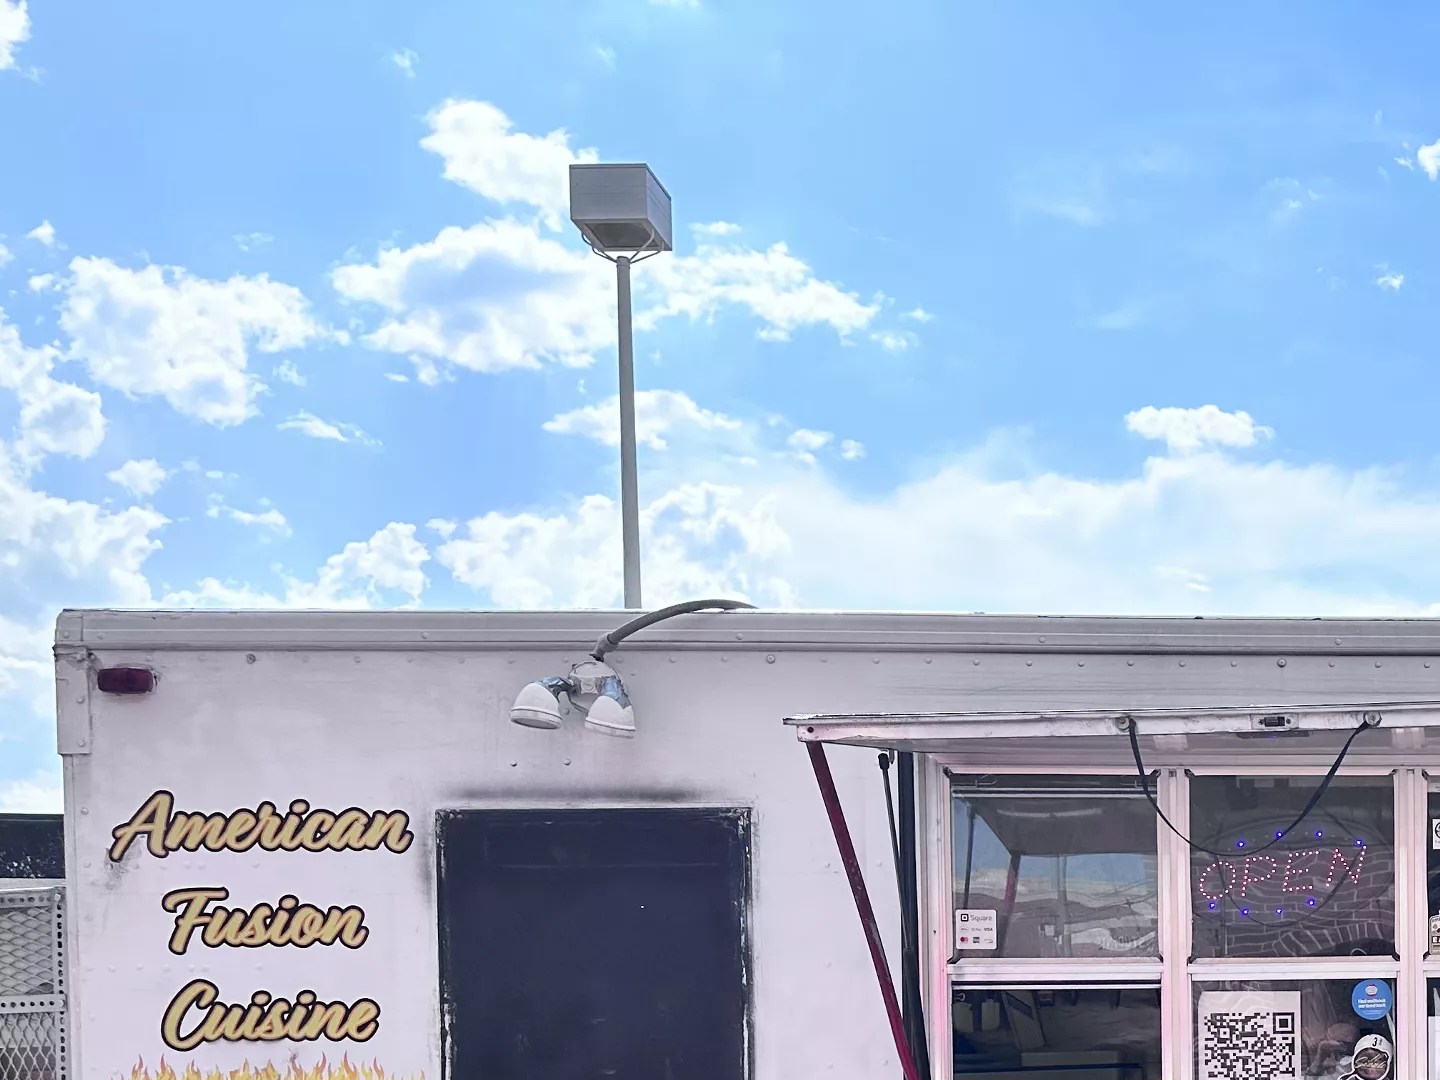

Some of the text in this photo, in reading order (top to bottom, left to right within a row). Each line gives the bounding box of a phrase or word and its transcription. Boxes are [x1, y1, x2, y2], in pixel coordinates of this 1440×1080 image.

[110, 790, 414, 861] American
[1199, 845, 1368, 900] OPEN
[162, 887, 368, 954] Fusion
[161, 979, 380, 1051] Cuisine
